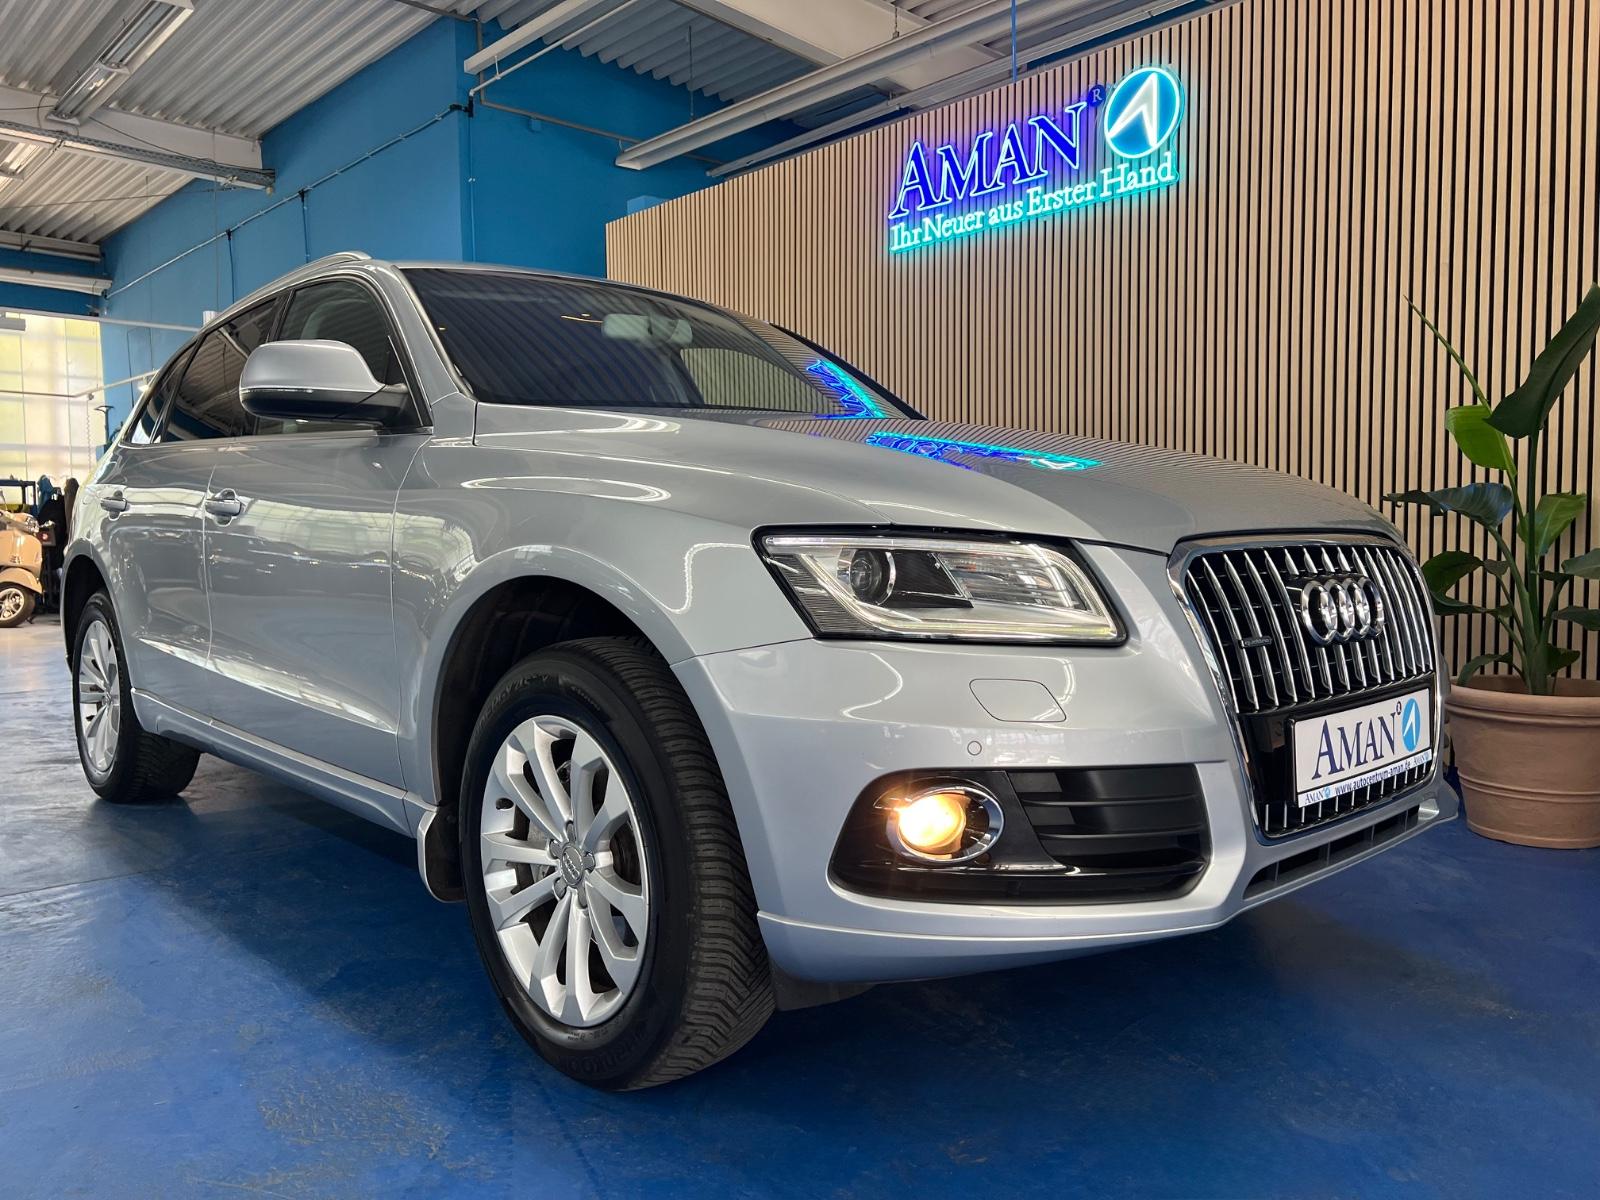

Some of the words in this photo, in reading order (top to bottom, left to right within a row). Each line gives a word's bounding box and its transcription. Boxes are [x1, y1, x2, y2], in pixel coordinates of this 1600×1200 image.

[888, 101, 1087, 219] AMAN
[890, 222, 922, 251] Ihr
[923, 210, 985, 242] Neuer
[988, 199, 1024, 226] aus
[1026, 181, 1097, 216] Erster
[1100, 151, 1176, 195] Hand
[1311, 712, 1396, 780] AMAN
